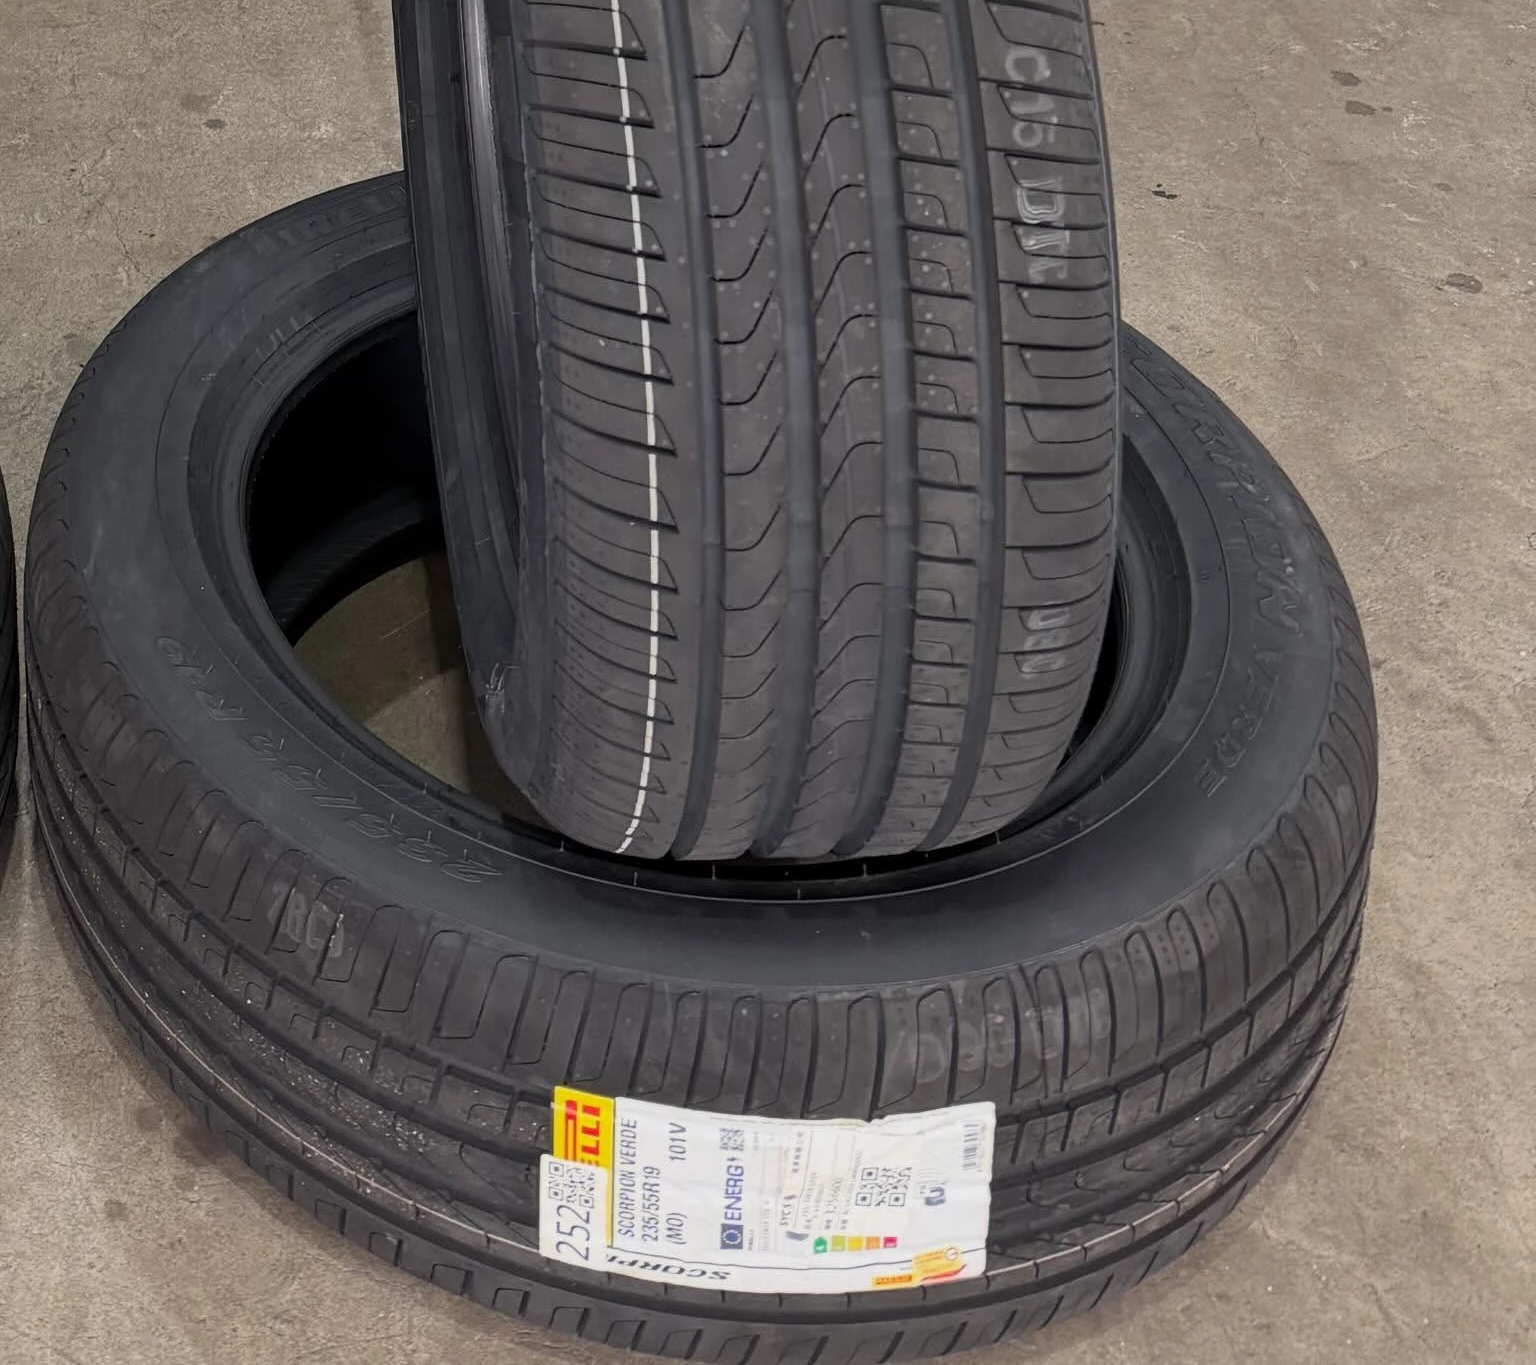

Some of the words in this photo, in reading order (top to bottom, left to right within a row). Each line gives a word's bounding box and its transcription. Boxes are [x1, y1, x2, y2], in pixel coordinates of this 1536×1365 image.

[620, 1116, 638, 1166] VERDE
[668, 1121, 688, 1162] 101V
[617, 1168, 636, 1239] SCORPION
[641, 1165, 660, 1243] 235/55R19
[723, 1164, 745, 1222] ENERG
[554, 1204, 591, 1262] 252
[666, 1211, 688, 1246] (MO)
